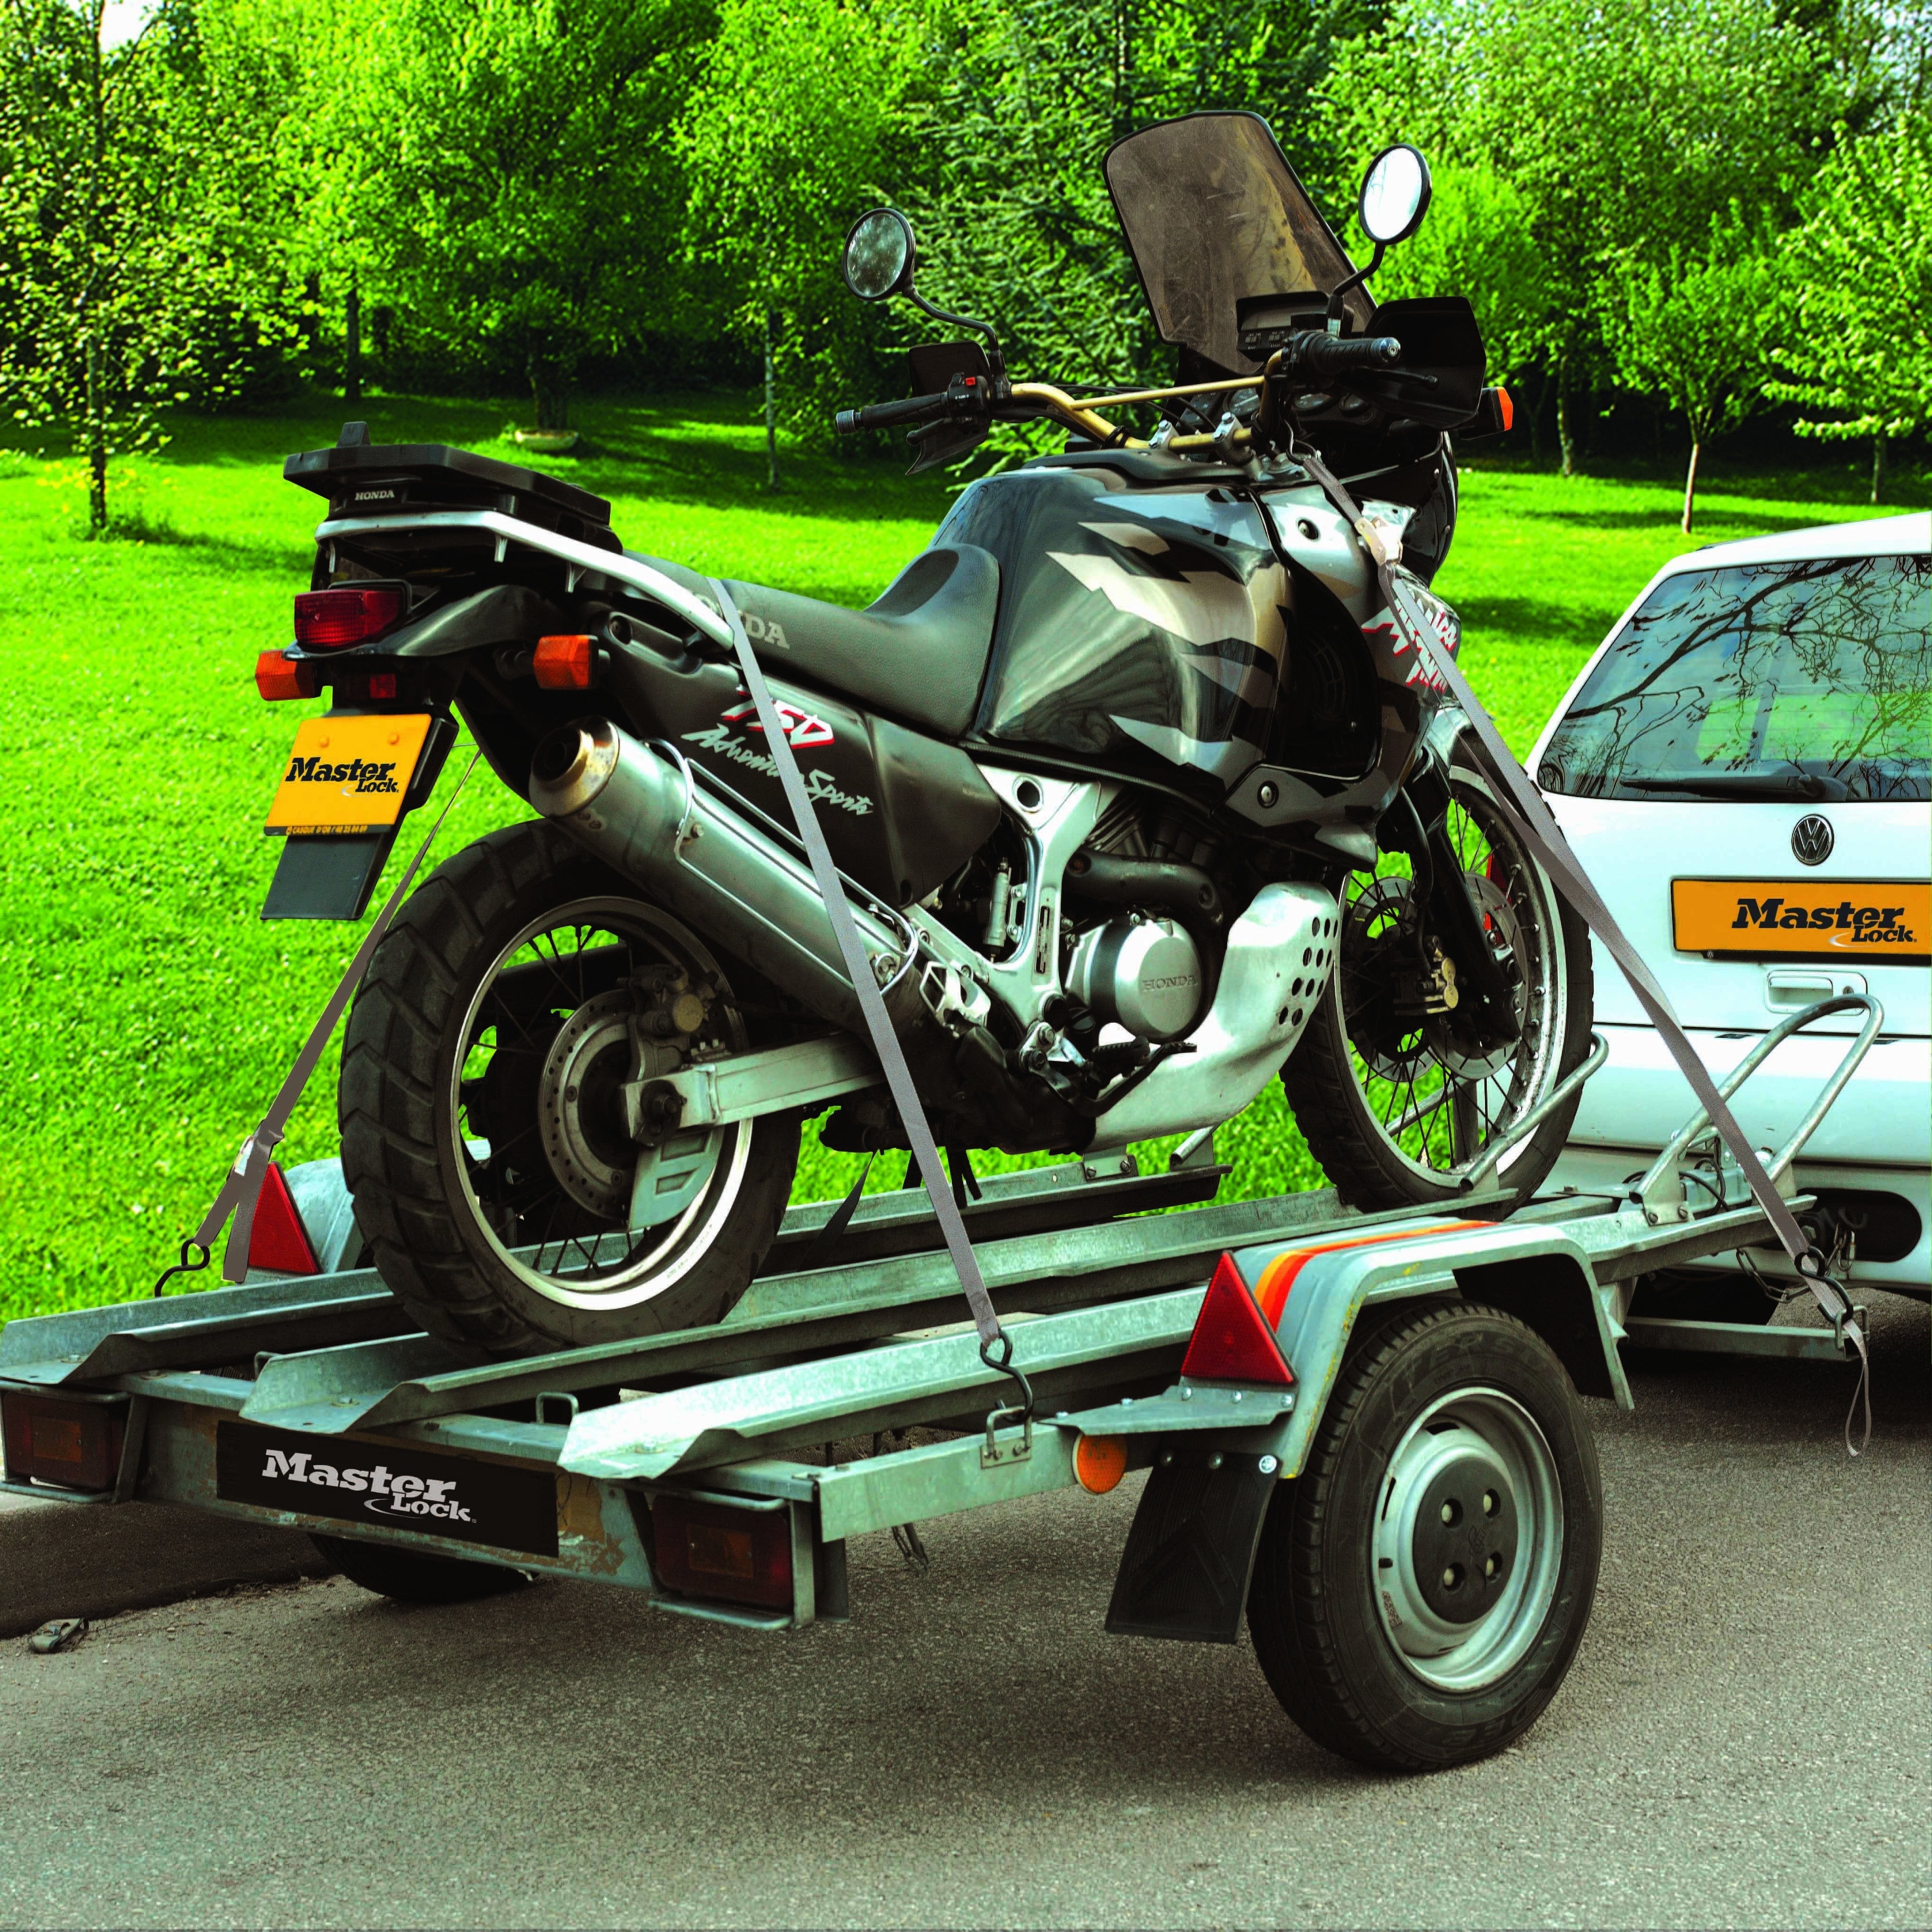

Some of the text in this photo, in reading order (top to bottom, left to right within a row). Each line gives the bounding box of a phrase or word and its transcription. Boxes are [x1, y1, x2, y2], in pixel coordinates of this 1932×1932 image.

[355, 490, 394, 501] HONDA
[285, 757, 396, 782] Master
[355, 778, 399, 793] Lock
[1731, 898, 1905, 929] Master
[1851, 925, 1914, 942] Lock
[1142, 975, 1198, 990] HONDA
[261, 1449, 457, 1503] Master
[390, 1492, 471, 1522] Lock
